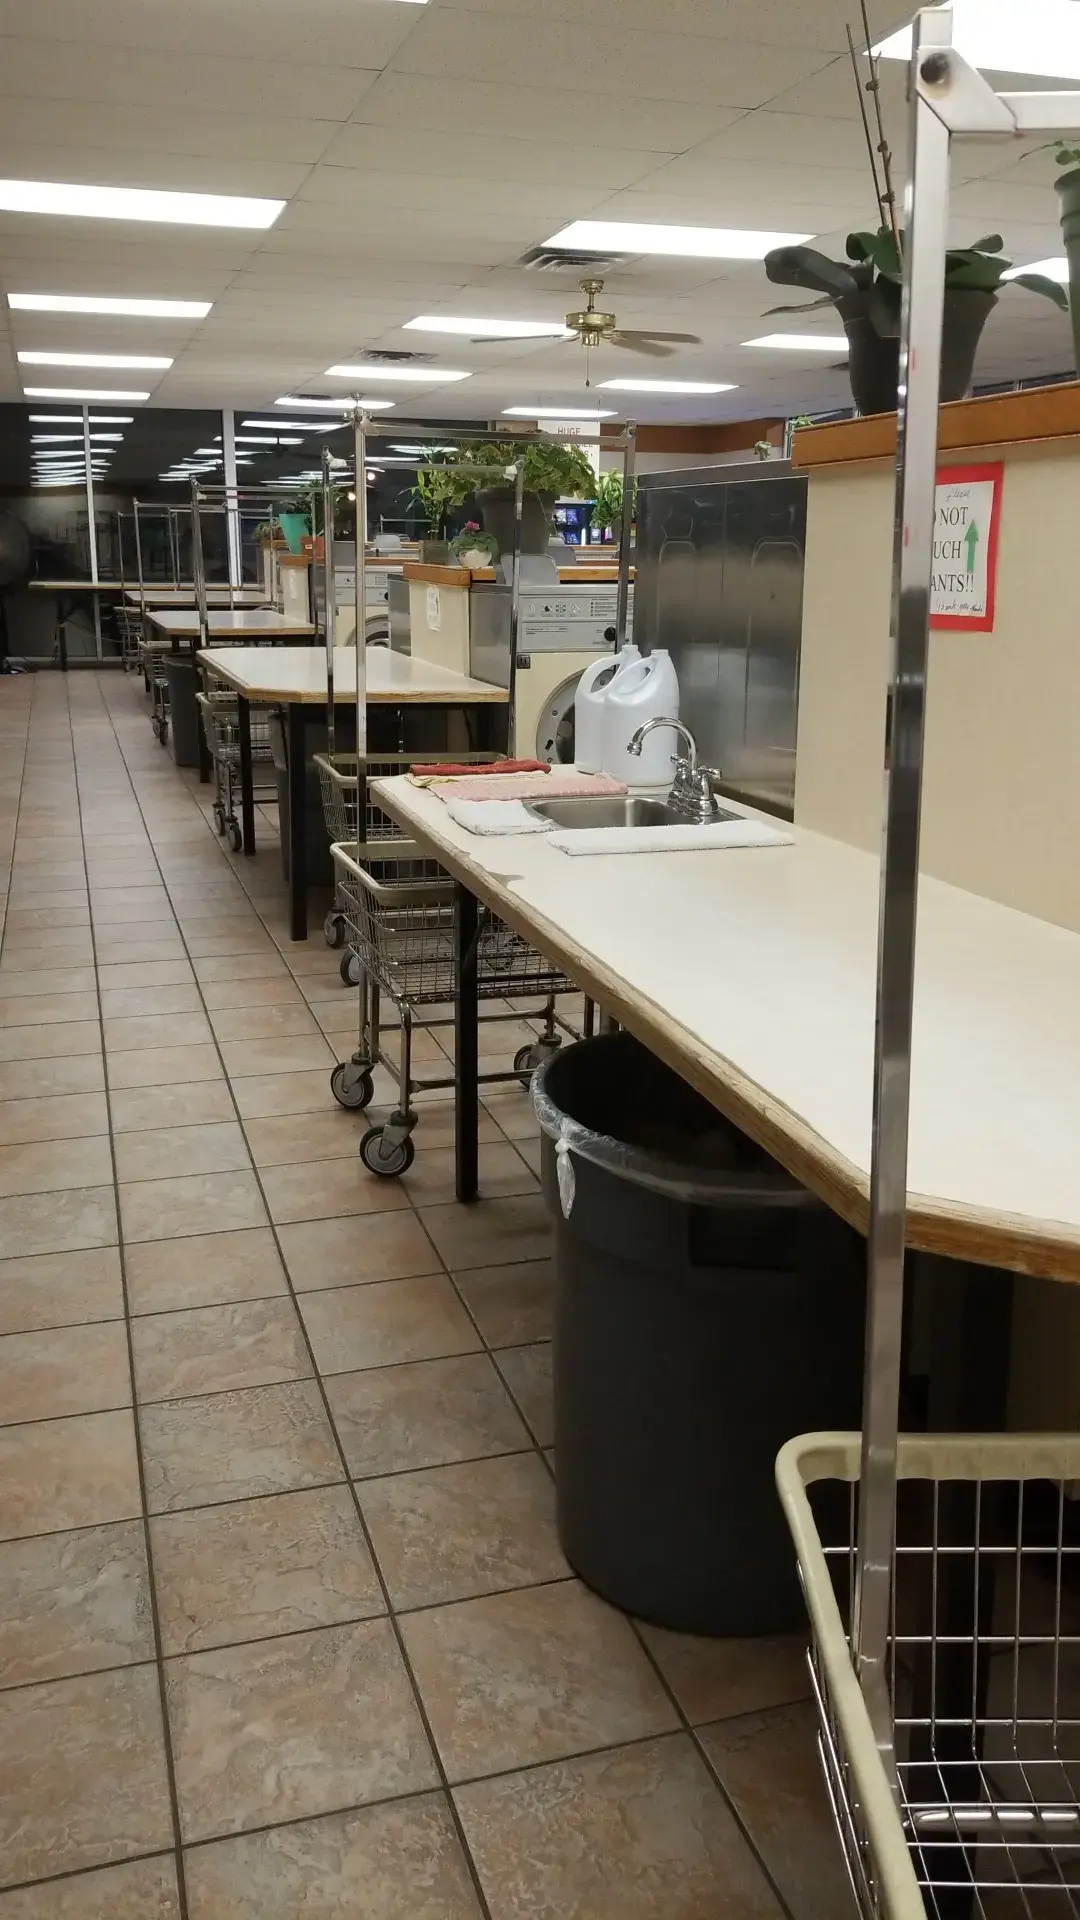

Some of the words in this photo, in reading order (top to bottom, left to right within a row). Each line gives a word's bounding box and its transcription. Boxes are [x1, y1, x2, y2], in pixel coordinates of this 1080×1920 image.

[939, 507, 969, 526] NOT
[933, 540, 962, 559] UCH
[930, 573, 974, 593] ANTS!!
